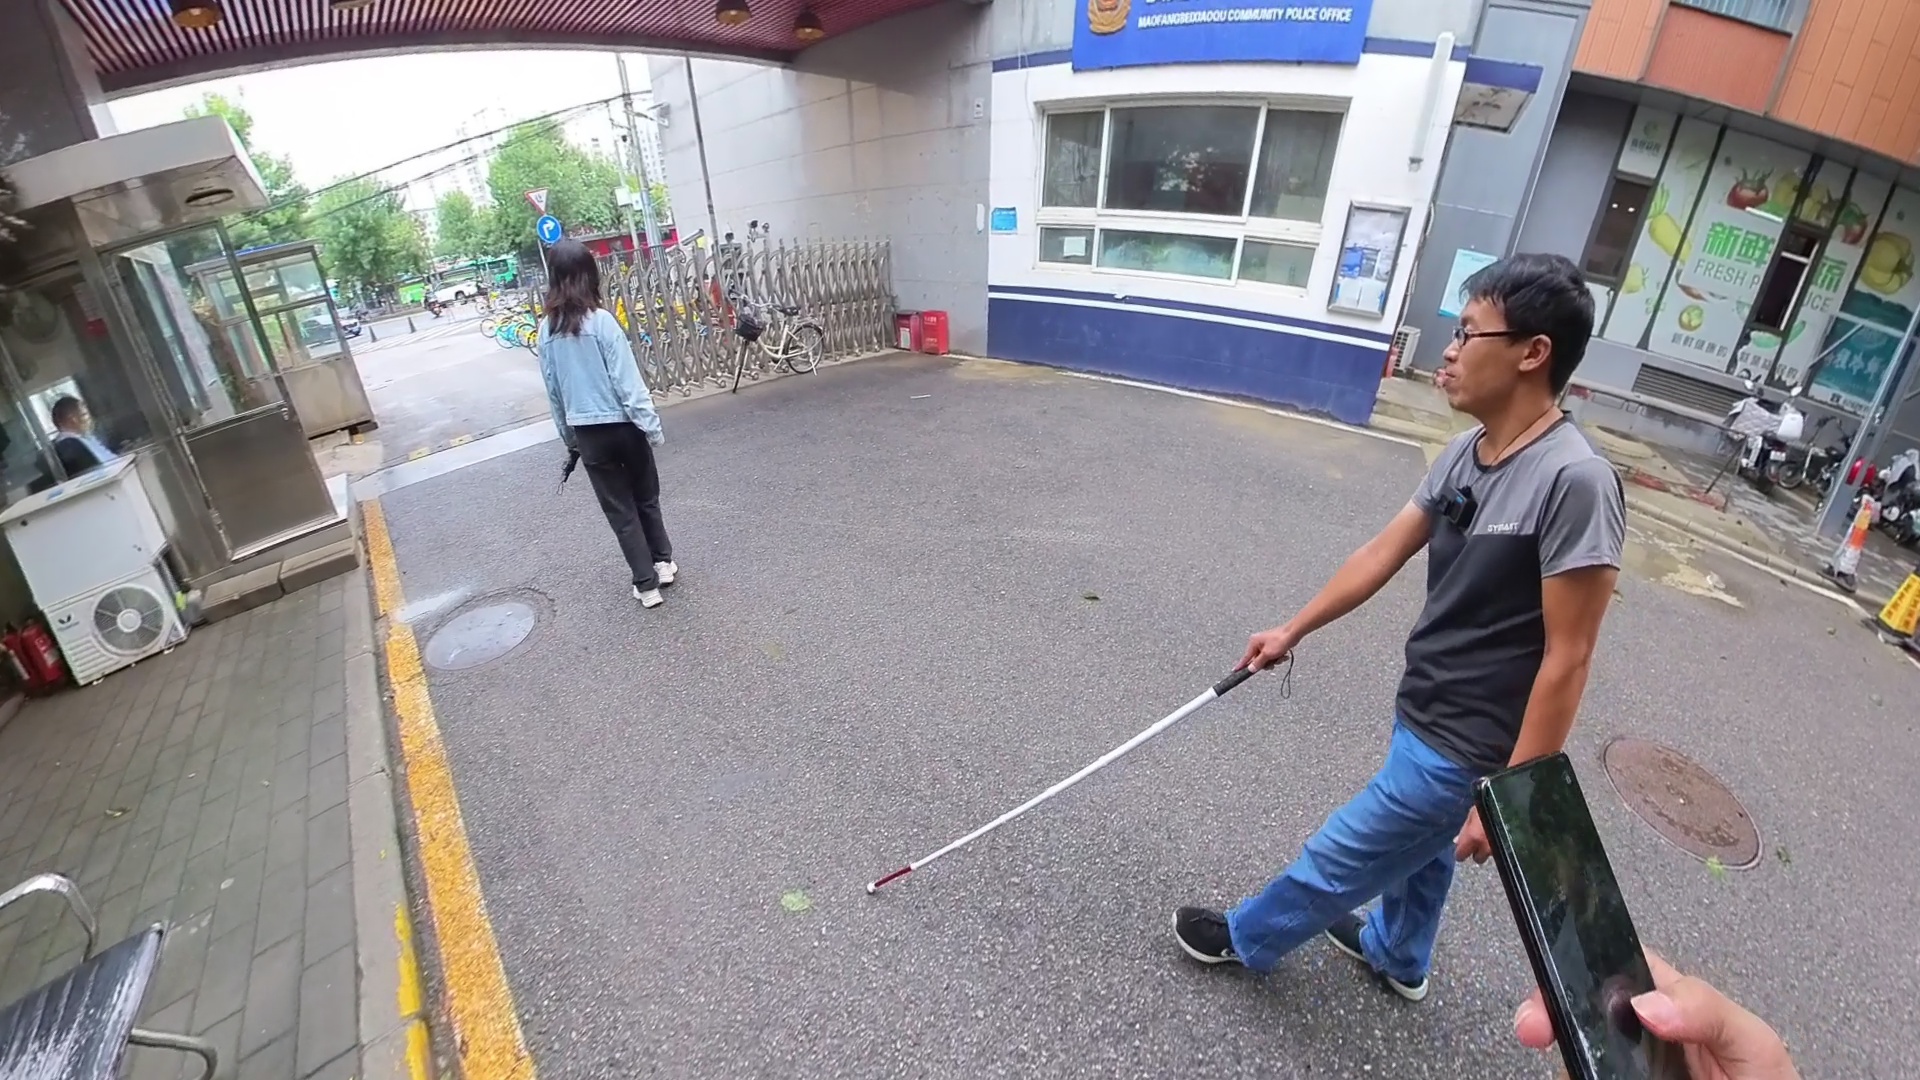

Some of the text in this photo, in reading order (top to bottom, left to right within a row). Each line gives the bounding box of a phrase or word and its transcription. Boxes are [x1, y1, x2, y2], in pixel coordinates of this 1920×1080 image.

[1227, 8, 1284, 22] COMMUNITY
[1285, 7, 1319, 21] POLICE
[1319, 7, 1353, 23] OFFICE
[1693, 258, 1747, 286] FRESH
